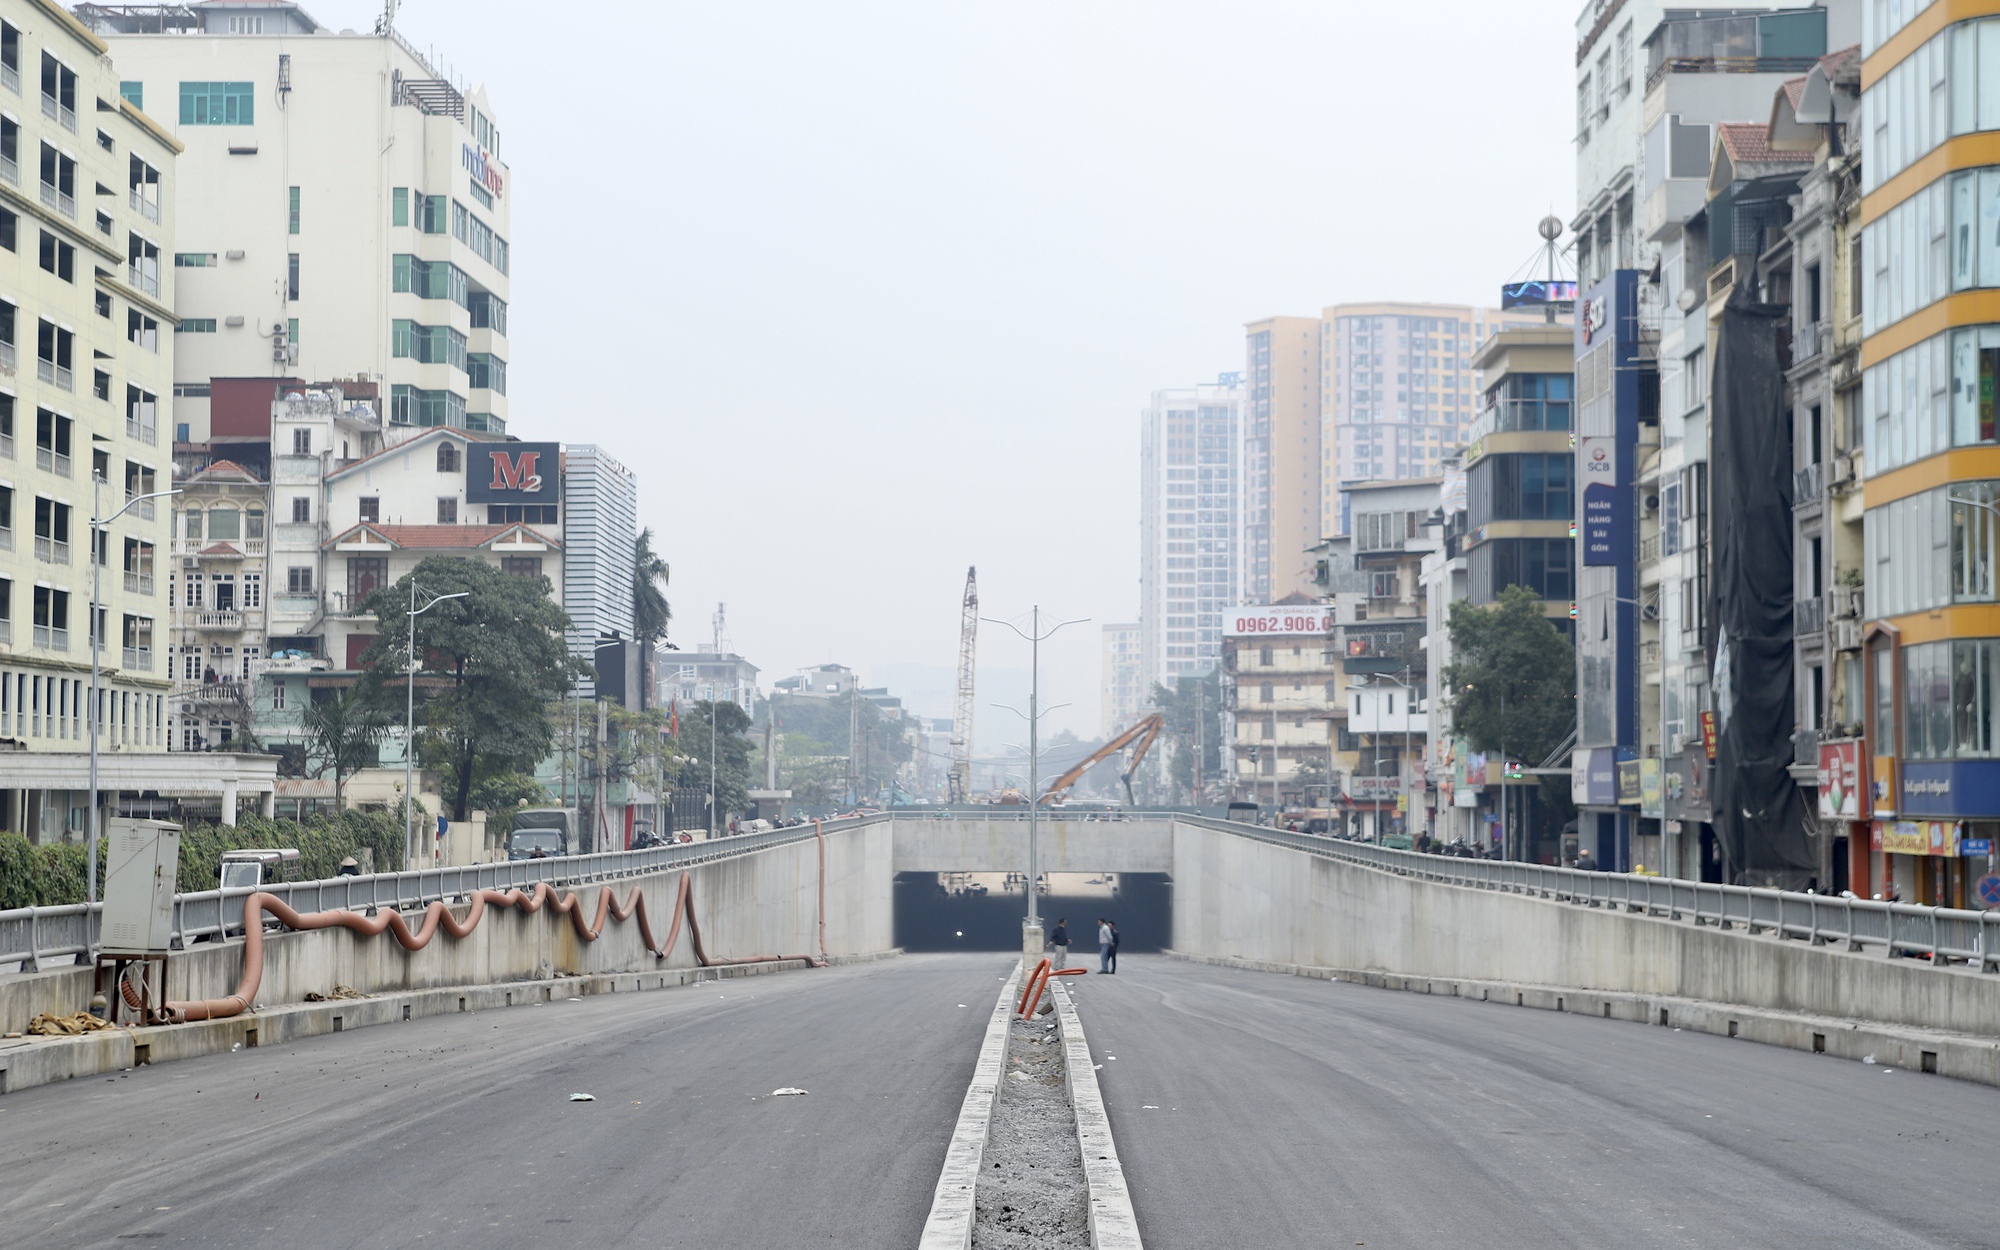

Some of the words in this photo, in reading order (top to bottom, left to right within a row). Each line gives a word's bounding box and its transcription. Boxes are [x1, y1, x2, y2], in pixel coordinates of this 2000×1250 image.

[462, 142, 503, 200] mobifone
[489, 451, 543, 492] M2
[1587, 462, 1610, 472] SCB
[1587, 501, 1611, 510] NGÂN
[1587, 515, 1612, 524] HÀNG
[1592, 529, 1607, 538] SÀI
[1591, 543, 1609, 552] GÒN
